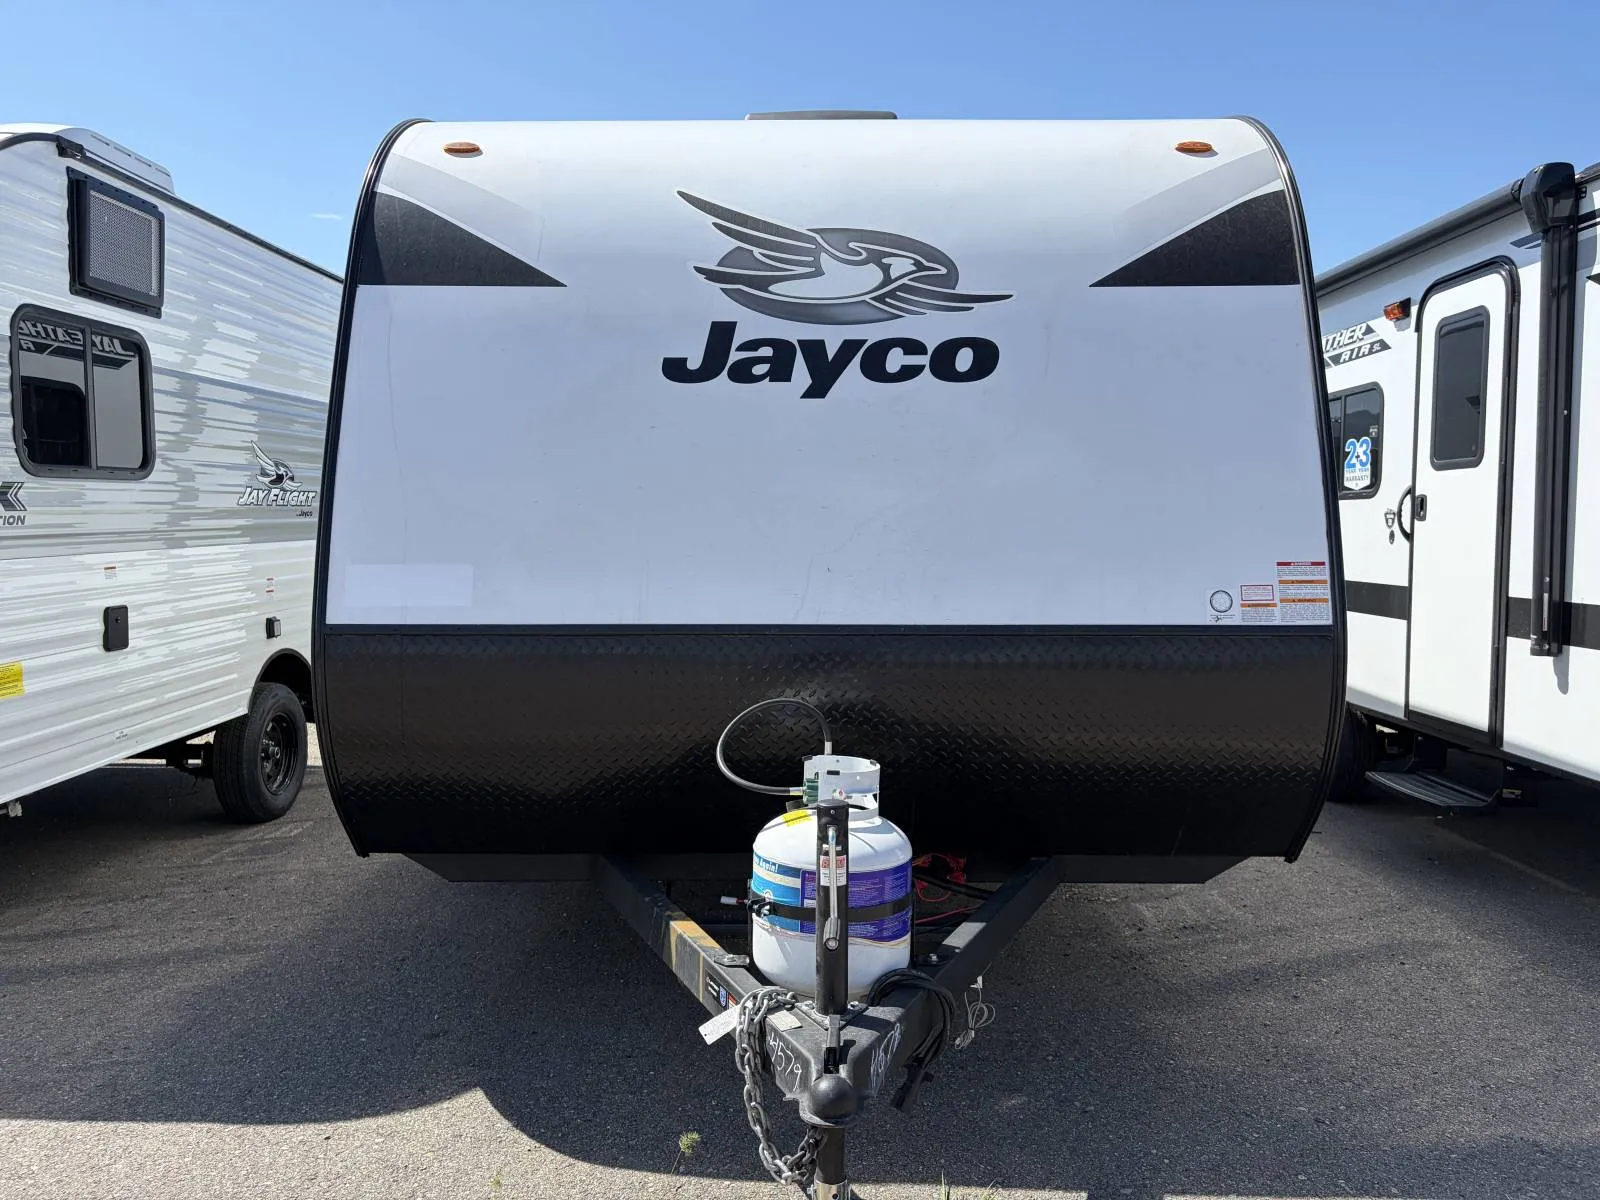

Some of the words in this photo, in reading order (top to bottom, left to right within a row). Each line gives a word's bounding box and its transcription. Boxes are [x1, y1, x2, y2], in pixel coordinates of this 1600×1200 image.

[662, 321, 1000, 399] Jayco
[1339, 343, 1371, 363] AIR
[238, 486, 268, 506] JAY
[266, 488, 317, 507] FLIGHT
